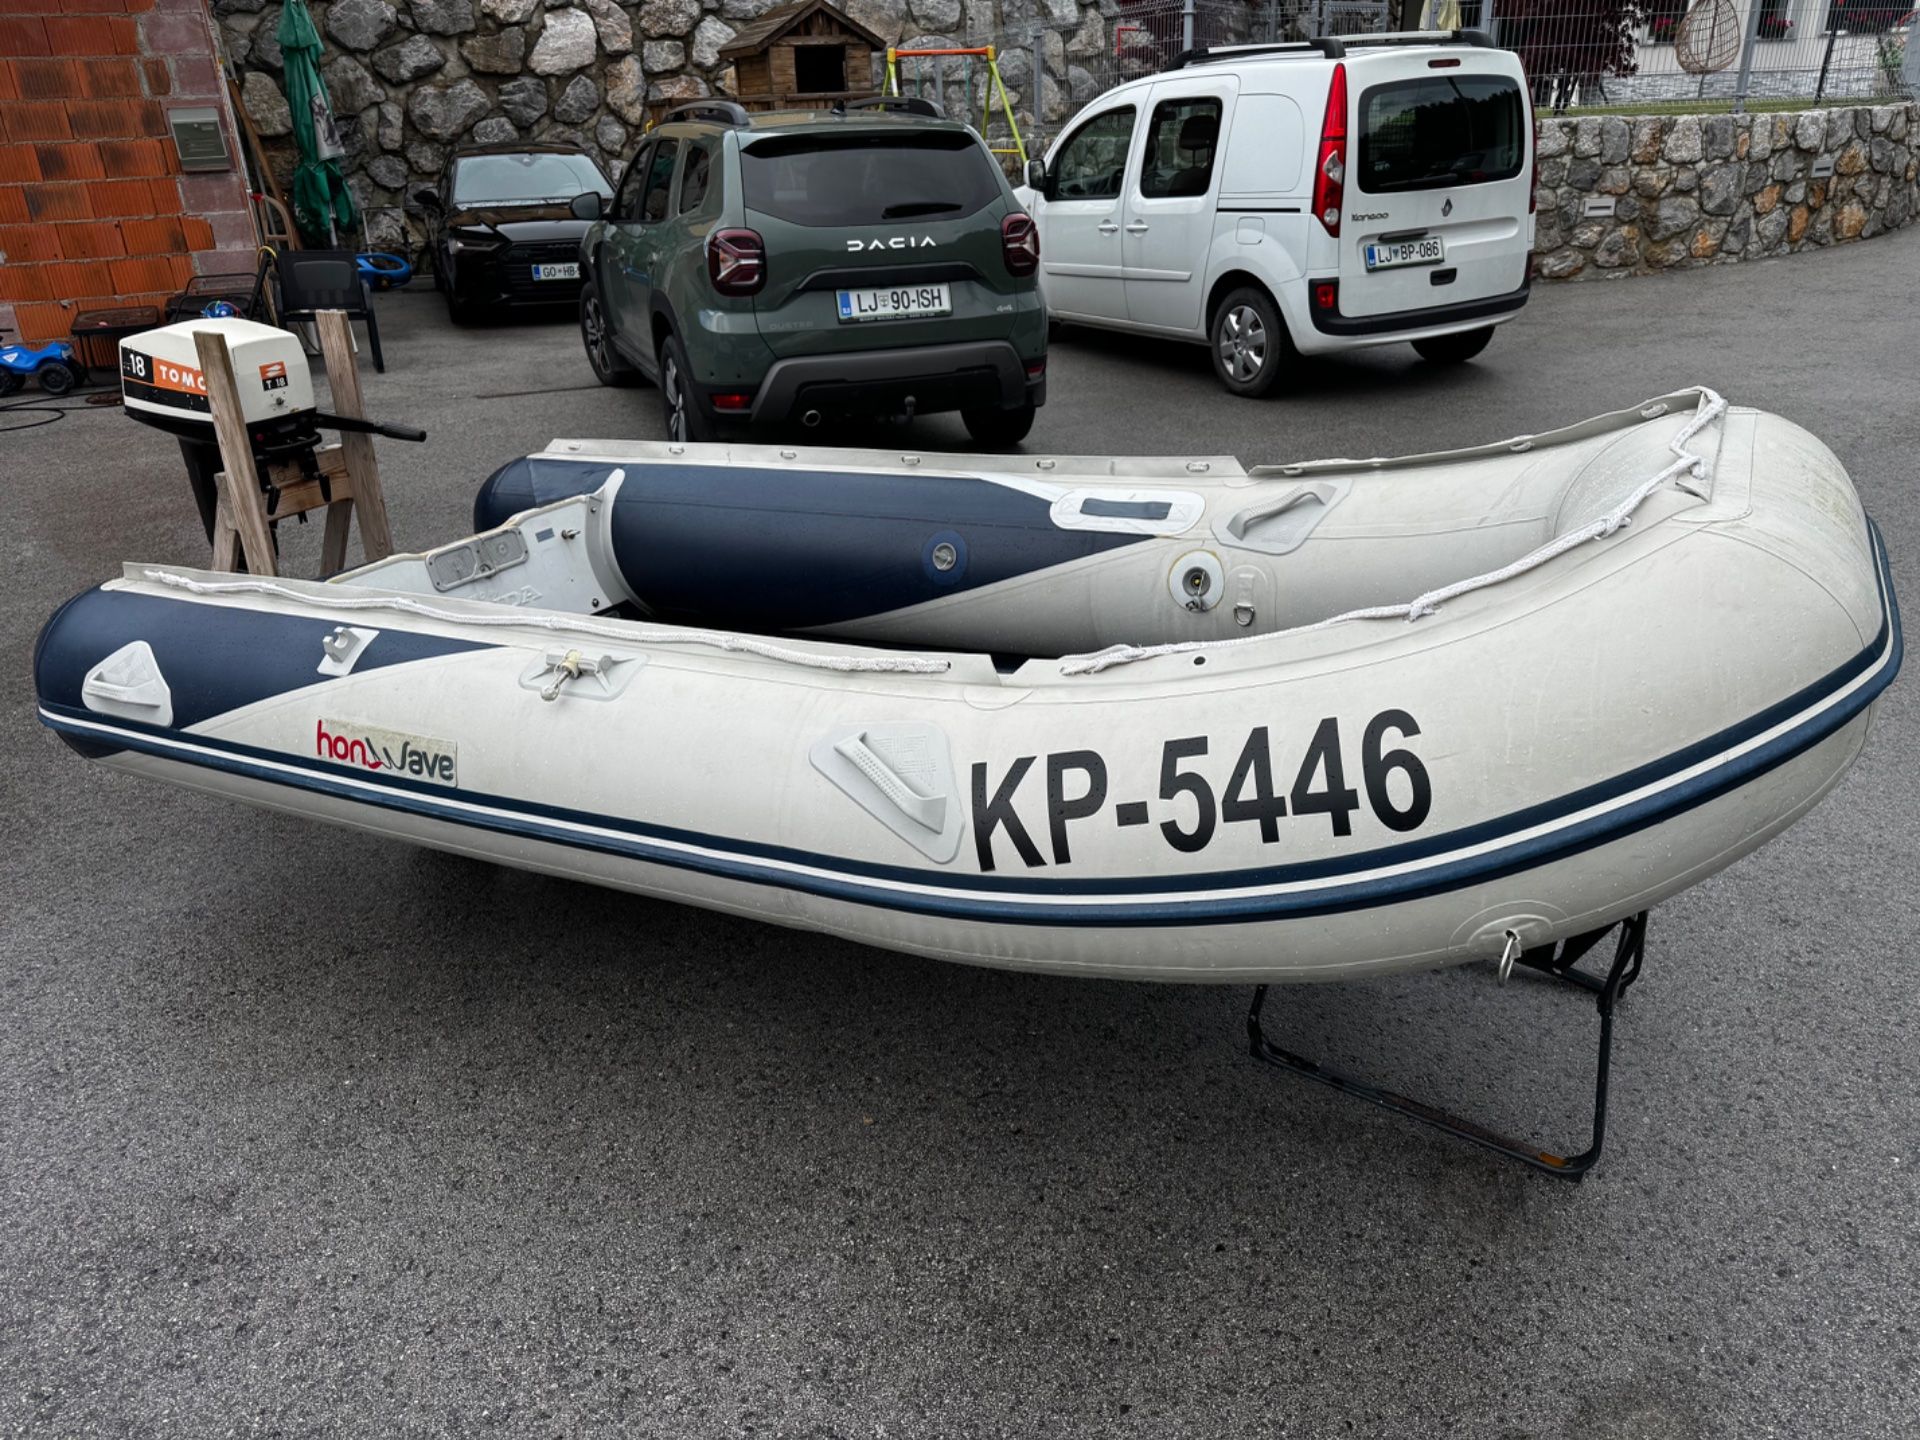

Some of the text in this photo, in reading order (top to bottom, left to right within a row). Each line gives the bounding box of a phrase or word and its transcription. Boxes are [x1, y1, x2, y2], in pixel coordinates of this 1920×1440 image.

[847, 236, 936, 251] DACIA
[1378, 241, 1440, 263] LJ BP-086
[857, 287, 942, 313] LJ 90-ISH
[129, 353, 146, 377] 18
[971, 709, 1432, 872] KP-5446
